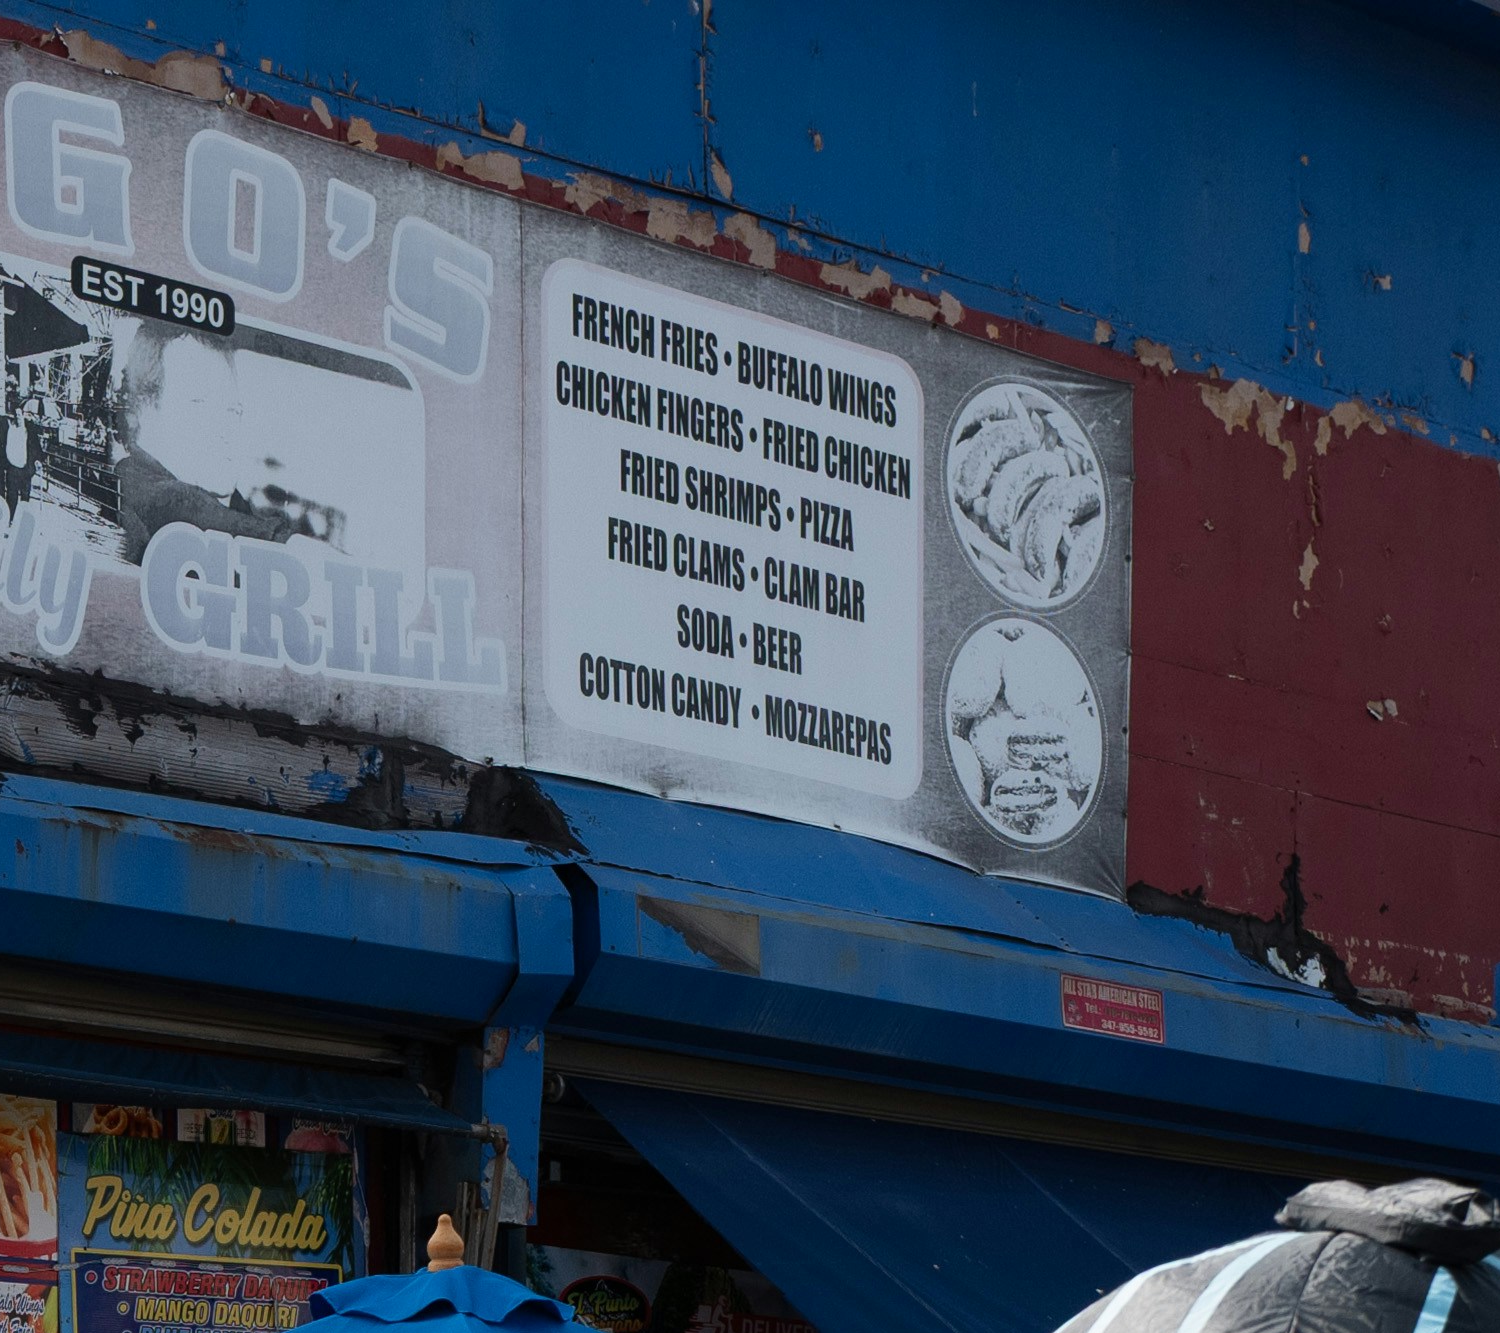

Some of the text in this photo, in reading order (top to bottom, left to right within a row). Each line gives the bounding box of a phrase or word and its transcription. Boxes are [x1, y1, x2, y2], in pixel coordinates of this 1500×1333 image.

[80, 262, 225, 328] EST 1990
[183, 129, 494, 378] O'S
[572, 293, 896, 428] FRENCH FRIES BUFFALO WINGS
[555, 362, 911, 500] CHICKEN FINGERS FRIED CHICKEN
[619, 449, 854, 552] FRIED SHRIMPS PIZZA
[139, 521, 508, 694] GRILL
[607, 516, 865, 623] FRIED CLAMS CLAM BAR
[676, 604, 802, 675] SODA BEER
[579, 652, 892, 766] COTTON CANDY MOZZAREPAS
[1064, 978, 1076, 994] ALL
[1098, 984, 1137, 1006] AMERICAN
[1138, 993, 1159, 1011] STEEL
[184, 1184, 327, 1250] Colada
[15, 1295, 45, 1317] Wings
[102, 1267, 239, 1300] STRAWBERRY
[135, 1298, 299, 1329] MANGO DAQUIRI
